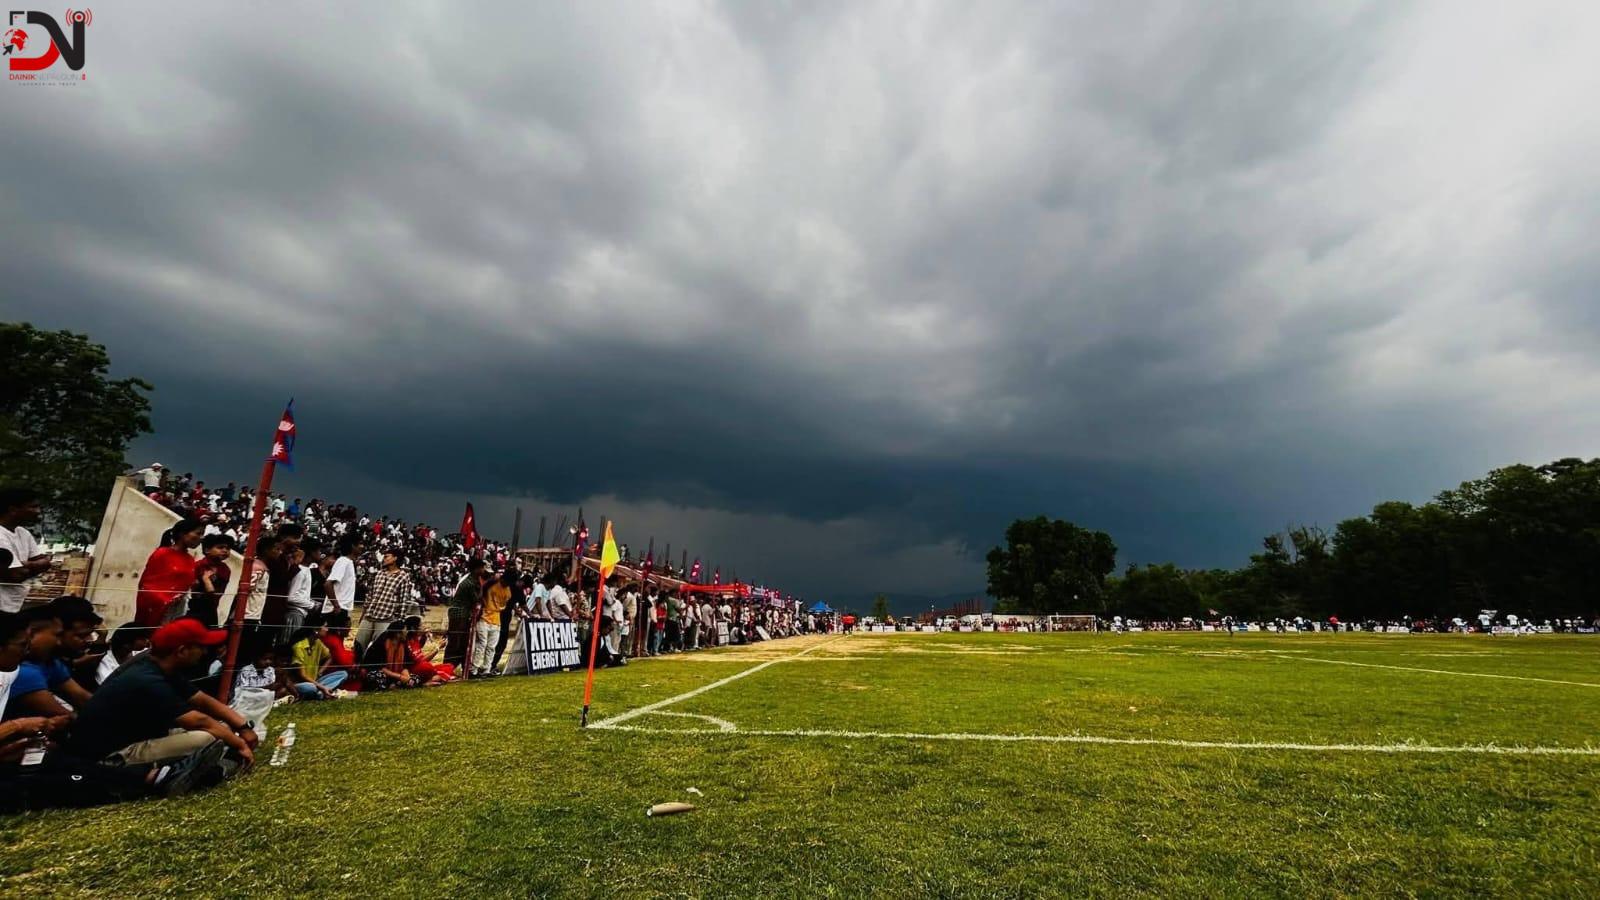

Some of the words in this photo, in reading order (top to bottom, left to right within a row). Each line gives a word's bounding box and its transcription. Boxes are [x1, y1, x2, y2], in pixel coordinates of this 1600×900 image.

[529, 622, 579, 651] XTREME
[531, 652, 559, 670] ENERGY
[560, 649, 580, 666] DRINK
